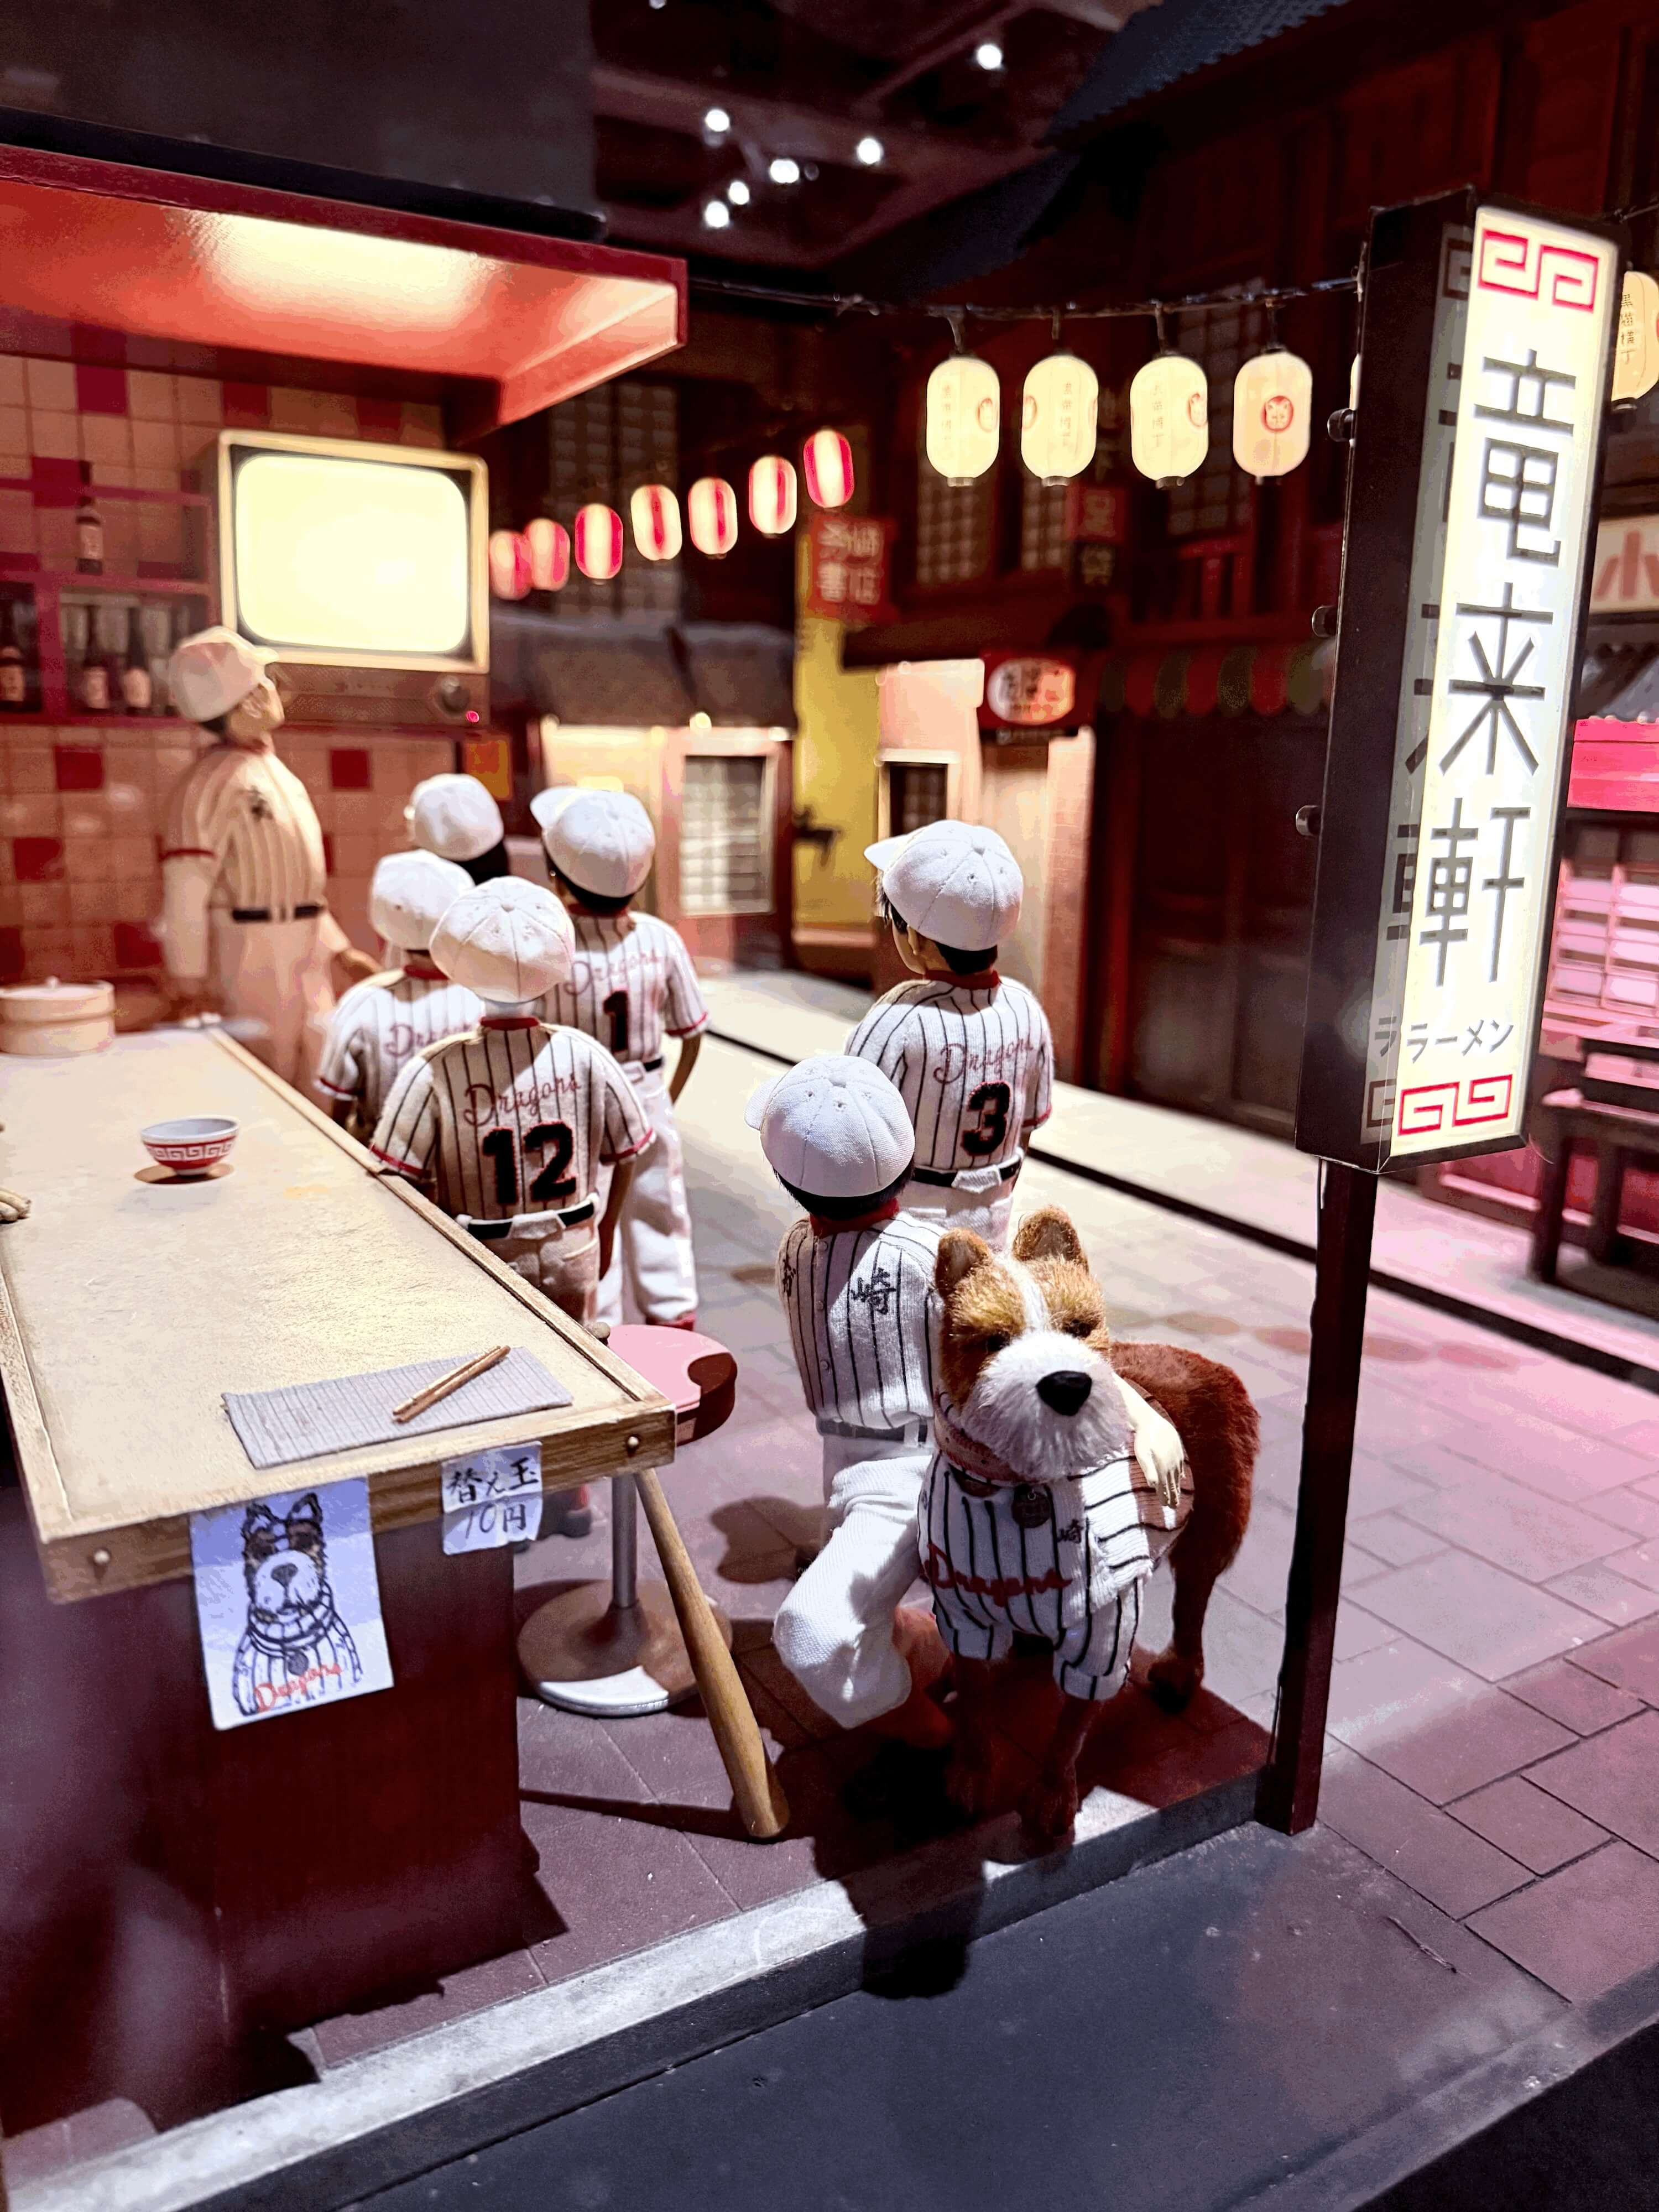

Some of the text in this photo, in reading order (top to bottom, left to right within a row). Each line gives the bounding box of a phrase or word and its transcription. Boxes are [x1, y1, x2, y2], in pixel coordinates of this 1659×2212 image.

[603, 988, 629, 1055] 1
[1406, 1019, 1515, 1064] ラーメン
[933, 1038, 1034, 1084] Dragons
[463, 1072, 581, 1126] Dragons
[961, 1079, 1011, 1157] 3
[482, 1120, 577, 1206] 12
[446, 1457, 539, 1504] 替え玉
[466, 1503, 528, 1540] 10円
